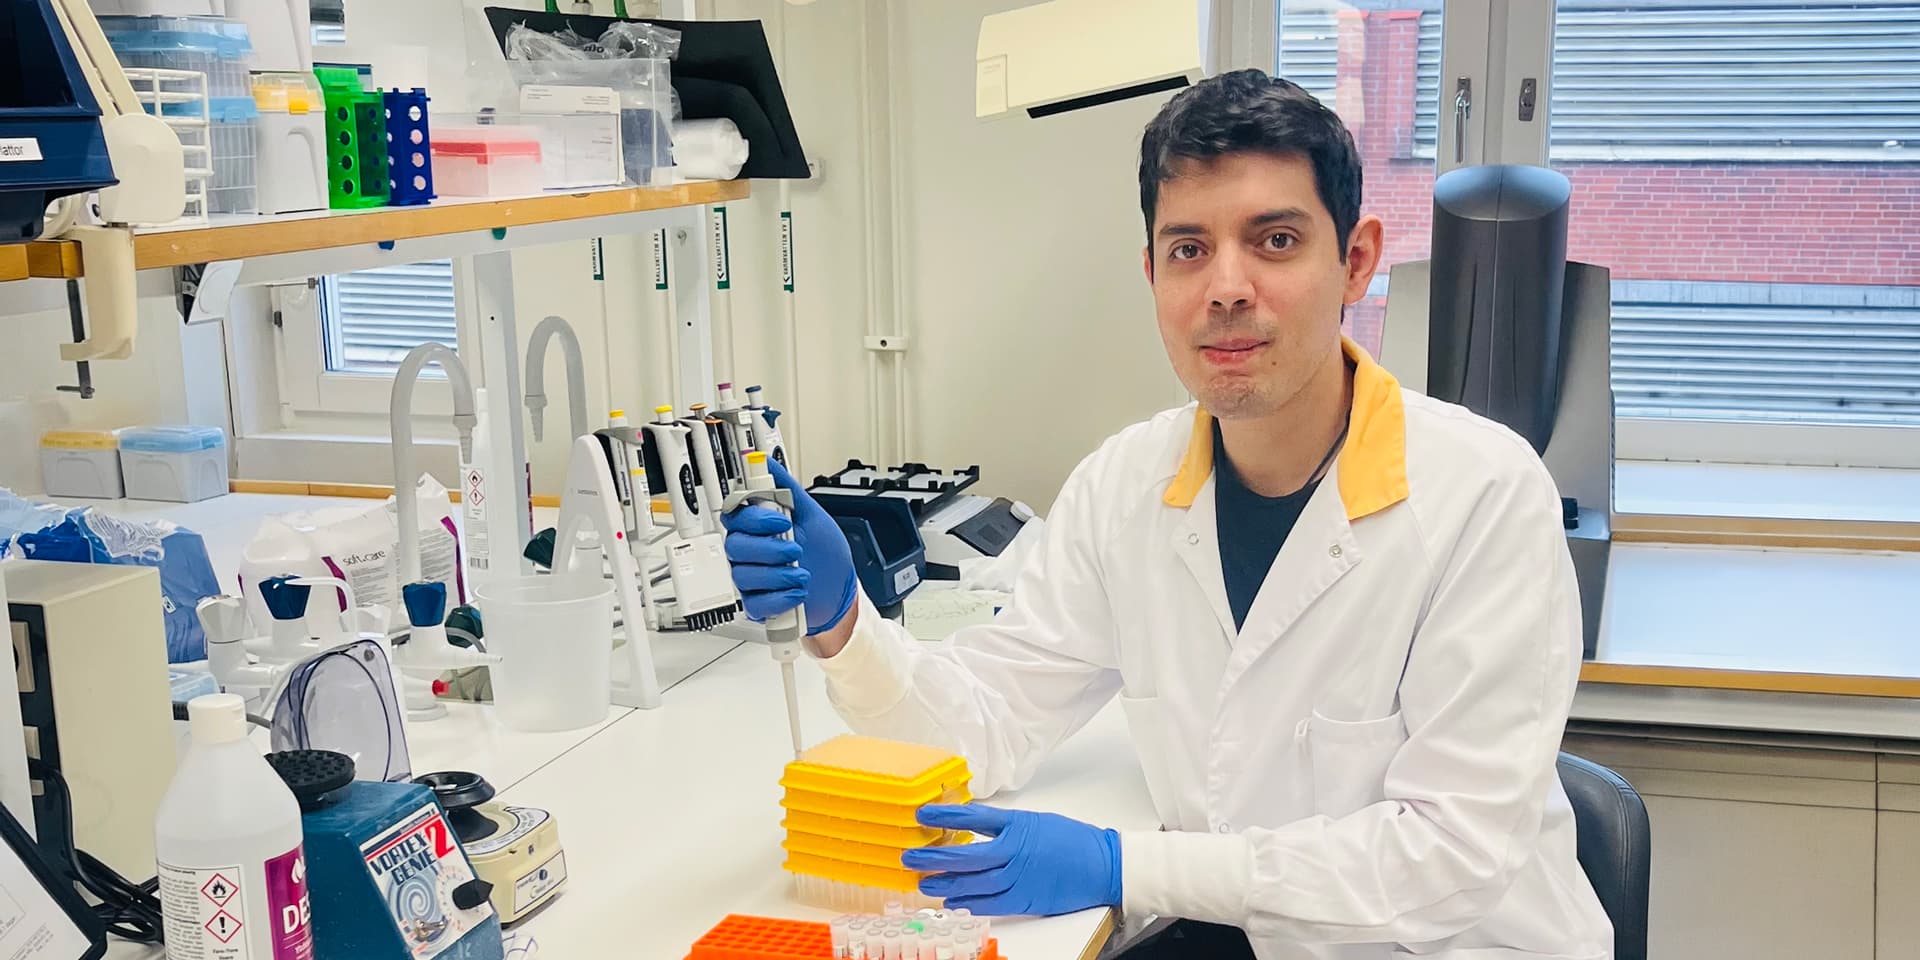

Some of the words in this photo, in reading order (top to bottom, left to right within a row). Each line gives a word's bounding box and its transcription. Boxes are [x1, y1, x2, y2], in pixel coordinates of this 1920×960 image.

[424, 818, 455, 859] 2
[390, 849, 437, 886] GENIE
[282, 891, 311, 934] DE
